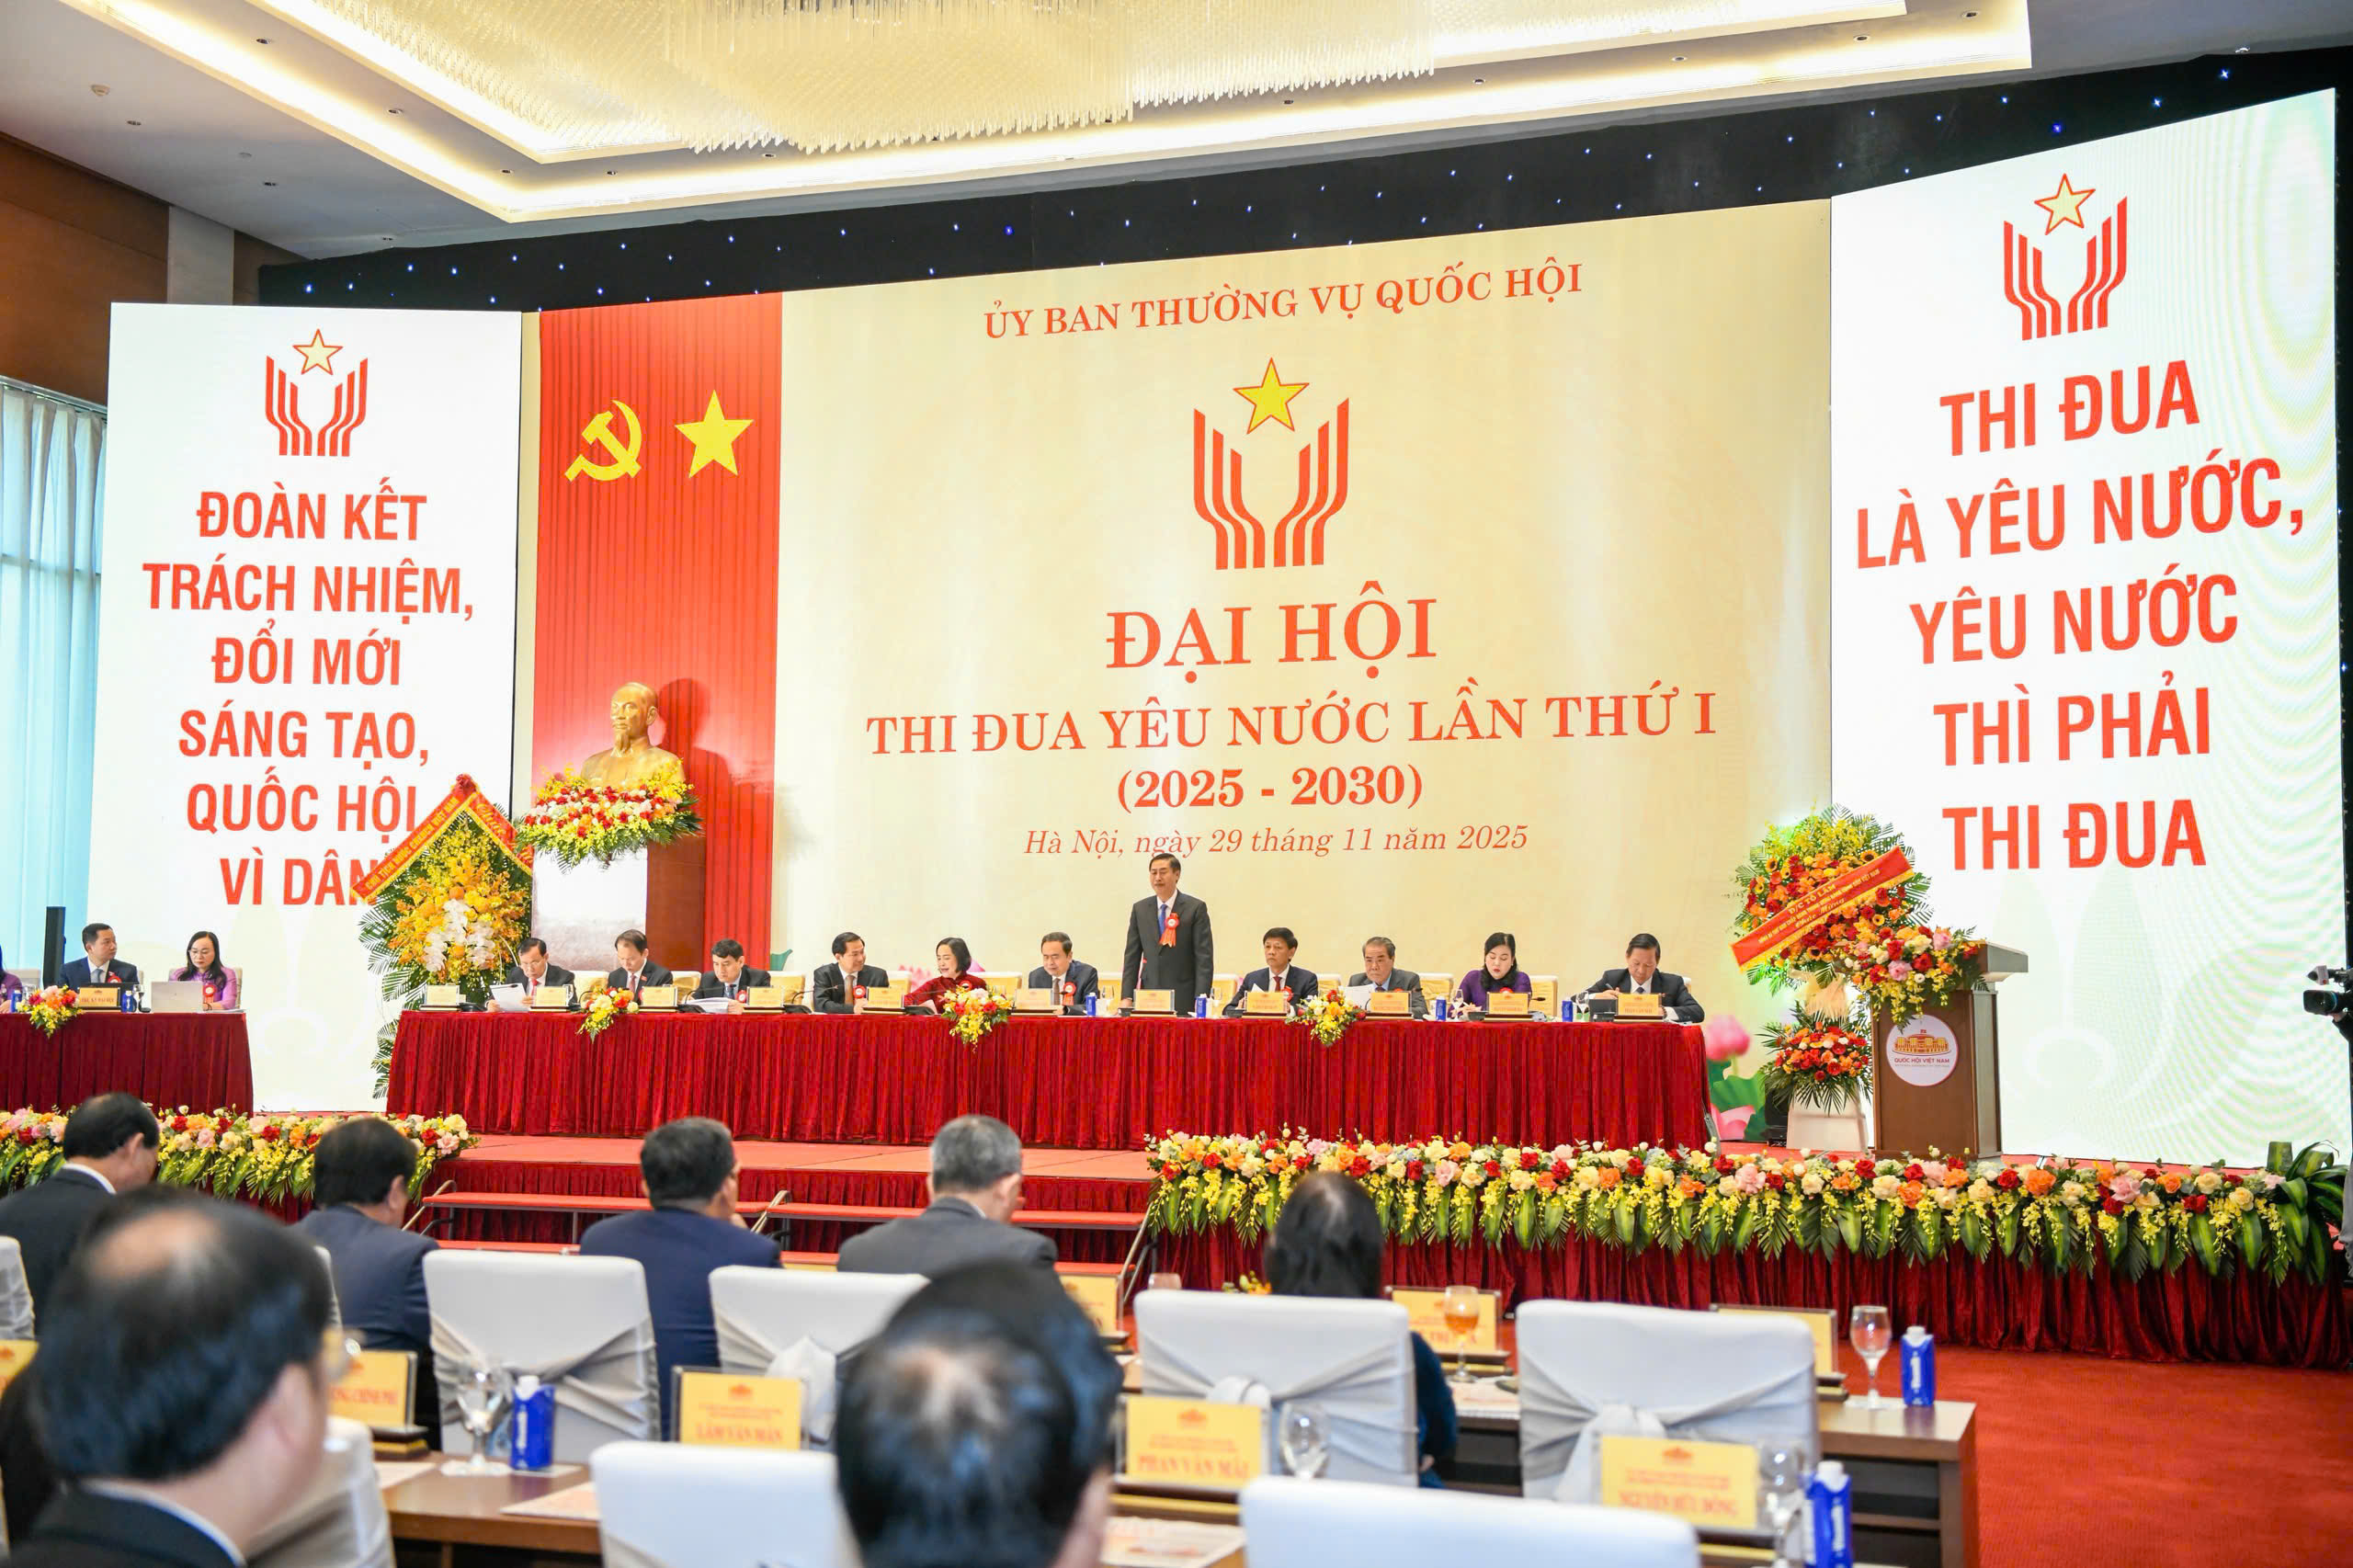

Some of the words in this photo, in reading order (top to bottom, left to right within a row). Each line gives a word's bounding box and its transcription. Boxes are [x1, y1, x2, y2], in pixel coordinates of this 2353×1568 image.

[984, 298, 1033, 339] ỦY
[1043, 302, 1122, 335] BAN
[1131, 282, 1298, 329] THƯỜNG
[1308, 282, 1365, 320] VỤ
[1375, 260, 1492, 314] QUỐC
[1505, 256, 1582, 304] HỘI
[1938, 381, 2037, 457] THI
[2058, 359, 2200, 442] ĐUA
[195, 481, 326, 540] ĐOÀN
[343, 475, 427, 541] KẾT
[1857, 487, 1927, 570] LÀ
[1945, 477, 2065, 559] YÊU
[2093, 448, 2303, 545] NƯỚC,
[142, 552, 295, 611] TRÁCH
[313, 557, 473, 625] NHIỆM,
[1909, 585, 2027, 665] YÊU
[2052, 562, 2238, 655] NƯỚC
[210, 618, 293, 685] ĐỔI
[312, 628, 401, 687] MỚI
[1105, 606, 1252, 685] ĐẠI
[1278, 580, 1438, 679] HỘI
[178, 699, 308, 758] SÁNG
[324, 710, 428, 771] TẠO,
[867, 713, 957, 755] THI
[972, 710, 1086, 753] ĐUA
[1097, 696, 1211, 750] YÊU
[1227, 689, 1389, 746] NƯỚC
[1407, 676, 1529, 743] LẦN
[1544, 678, 1680, 738] THỨ
[1692, 690, 1717, 735] I
[1933, 683, 2030, 767] THÌ
[2057, 669, 2211, 761] PHẢI
[187, 765, 319, 835] QUỐC
[337, 775, 416, 845] HỘI
[1117, 769, 1245, 814] (2025
[1290, 764, 1423, 810] 2030)
[1023, 829, 1062, 854] Hà
[1070, 828, 1124, 859] Nội,
[1132, 830, 1202, 859] ngày
[1208, 828, 1244, 853] 29
[1251, 826, 1334, 858] tháng
[1345, 827, 1372, 851] 11
[1383, 828, 1447, 851] năm
[1455, 824, 1528, 848] 2025
[1941, 804, 2040, 870] THI
[2063, 798, 2207, 869] ĐUA
[220, 846, 264, 905] VÌ
